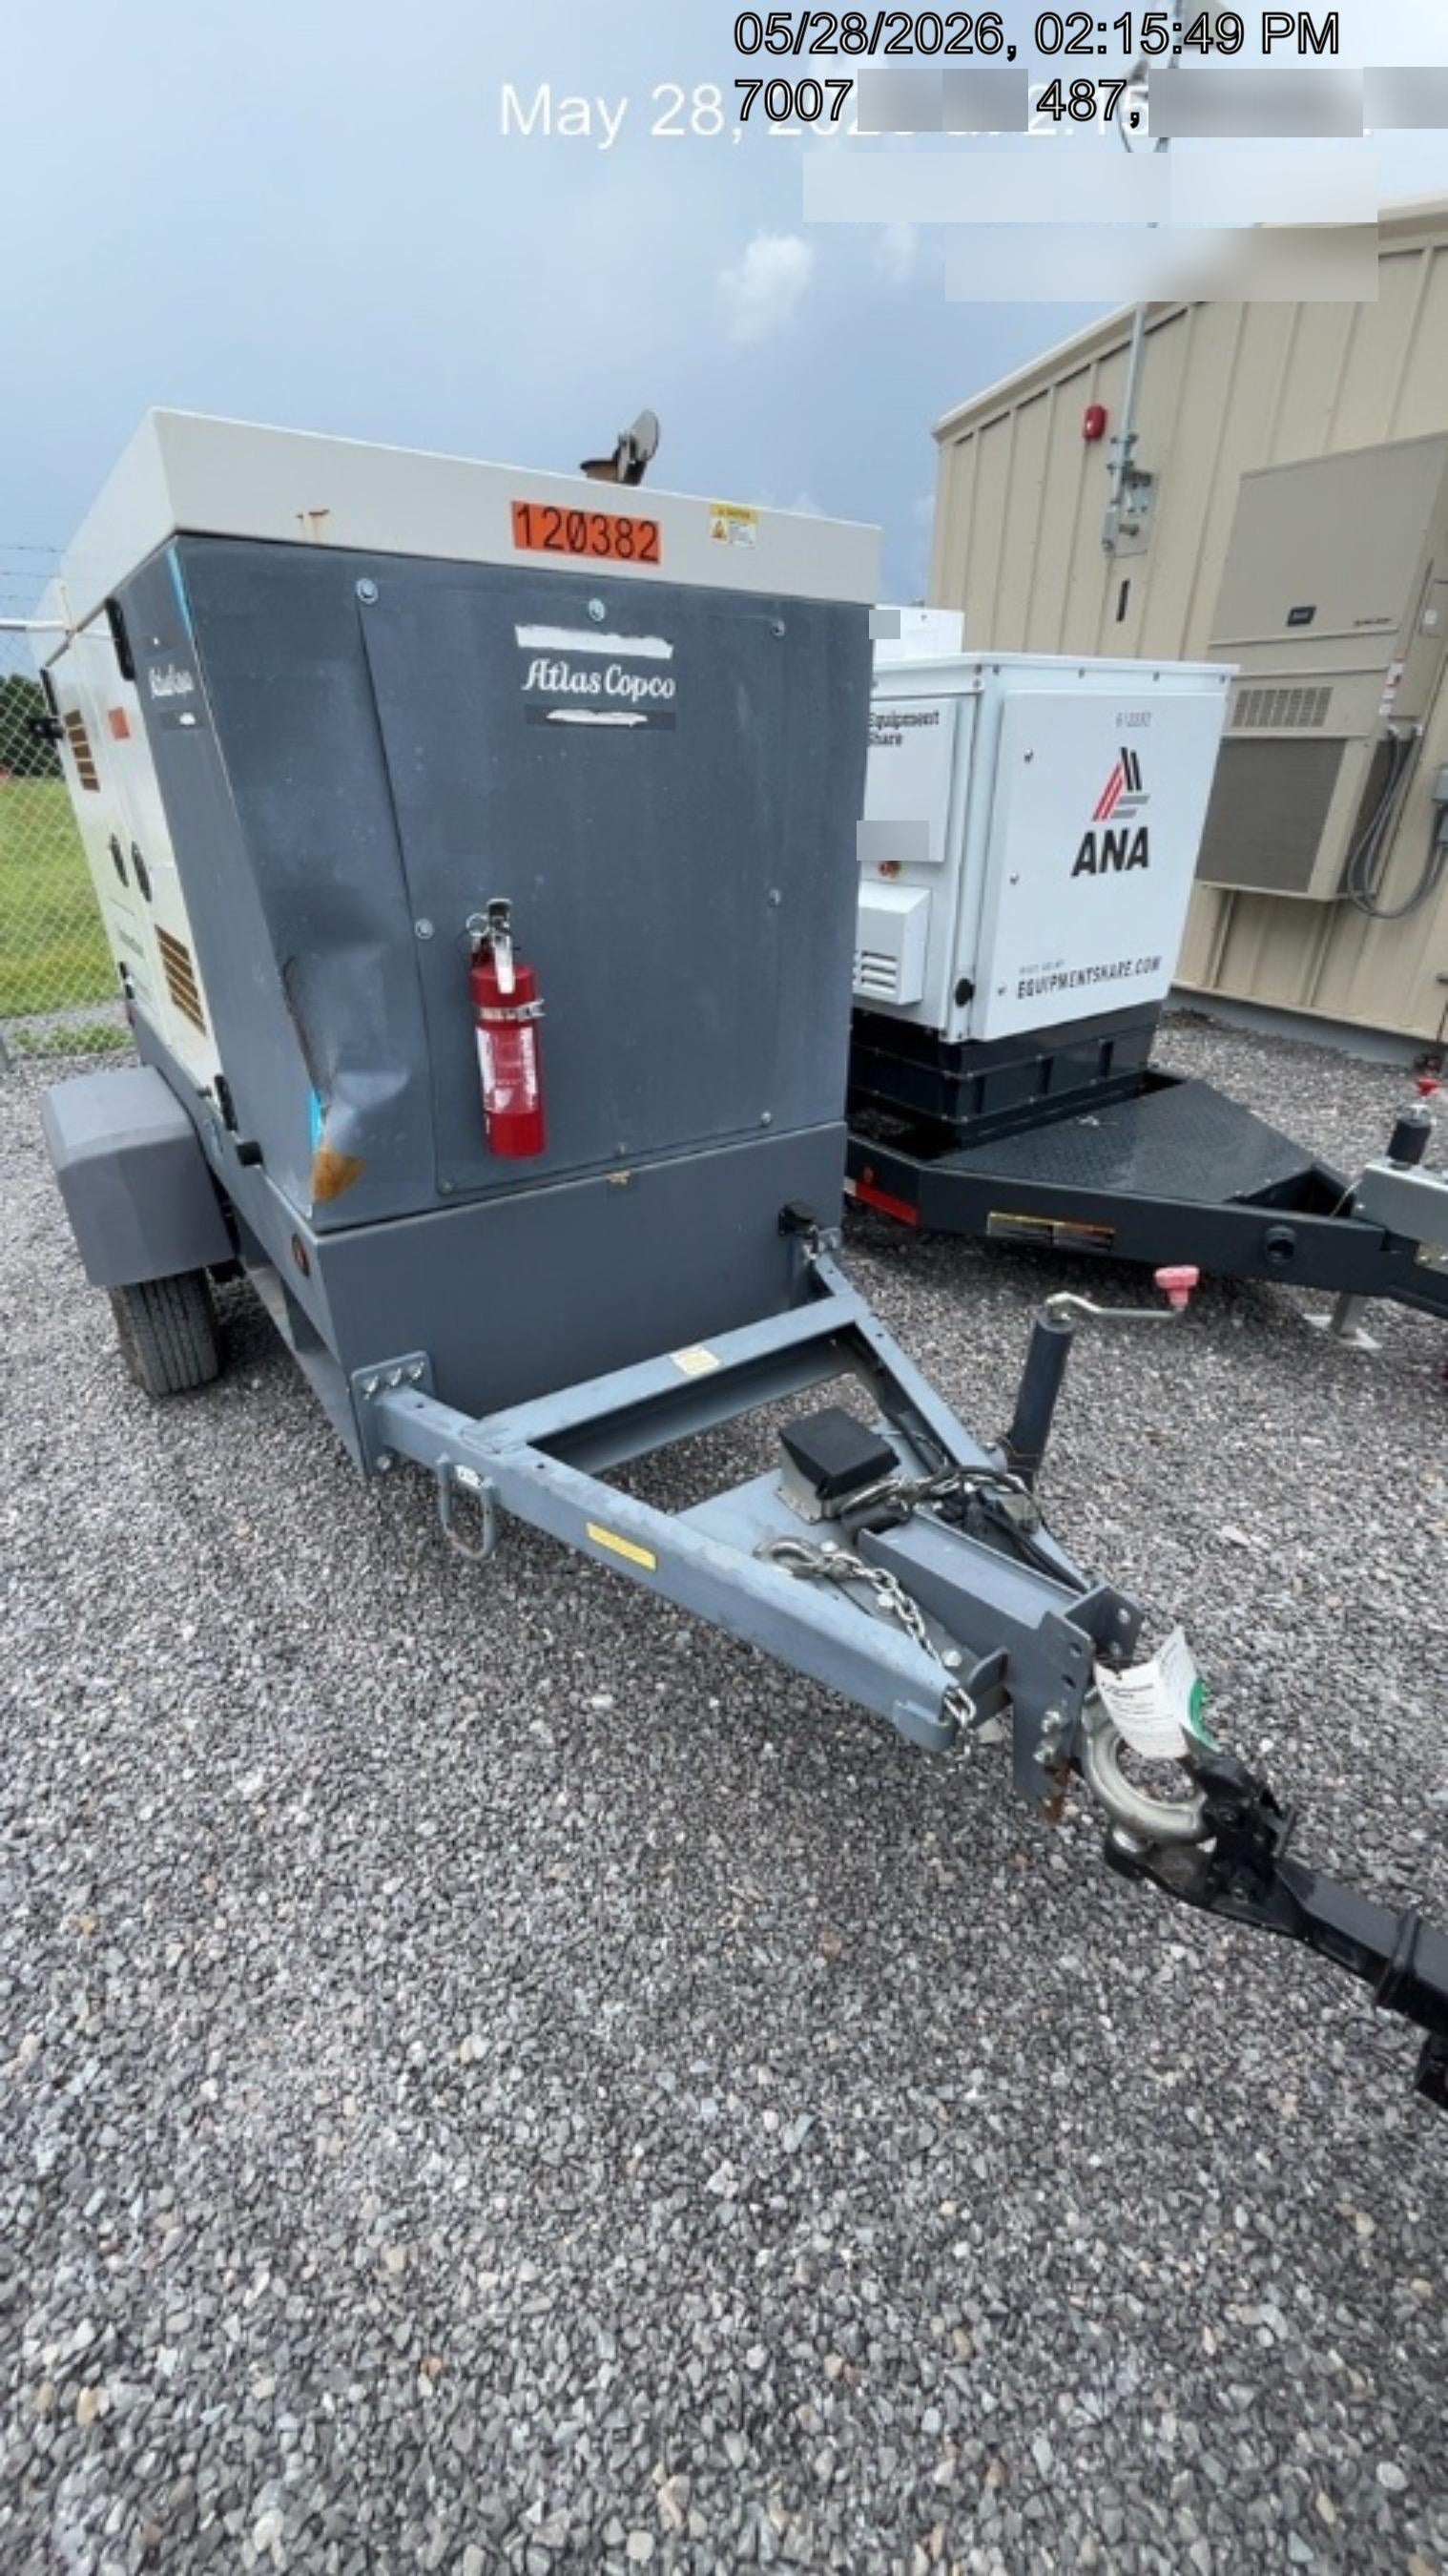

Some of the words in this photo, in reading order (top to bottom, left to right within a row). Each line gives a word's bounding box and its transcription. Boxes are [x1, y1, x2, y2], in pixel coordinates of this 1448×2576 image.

[516, 503, 660, 563] 120382
[522, 657, 602, 695] Atlas
[605, 664, 676, 702] Copco
[1070, 826, 1149, 878] ANA
[1018, 956, 1162, 999] EQUIPMENTSHARE.COM
